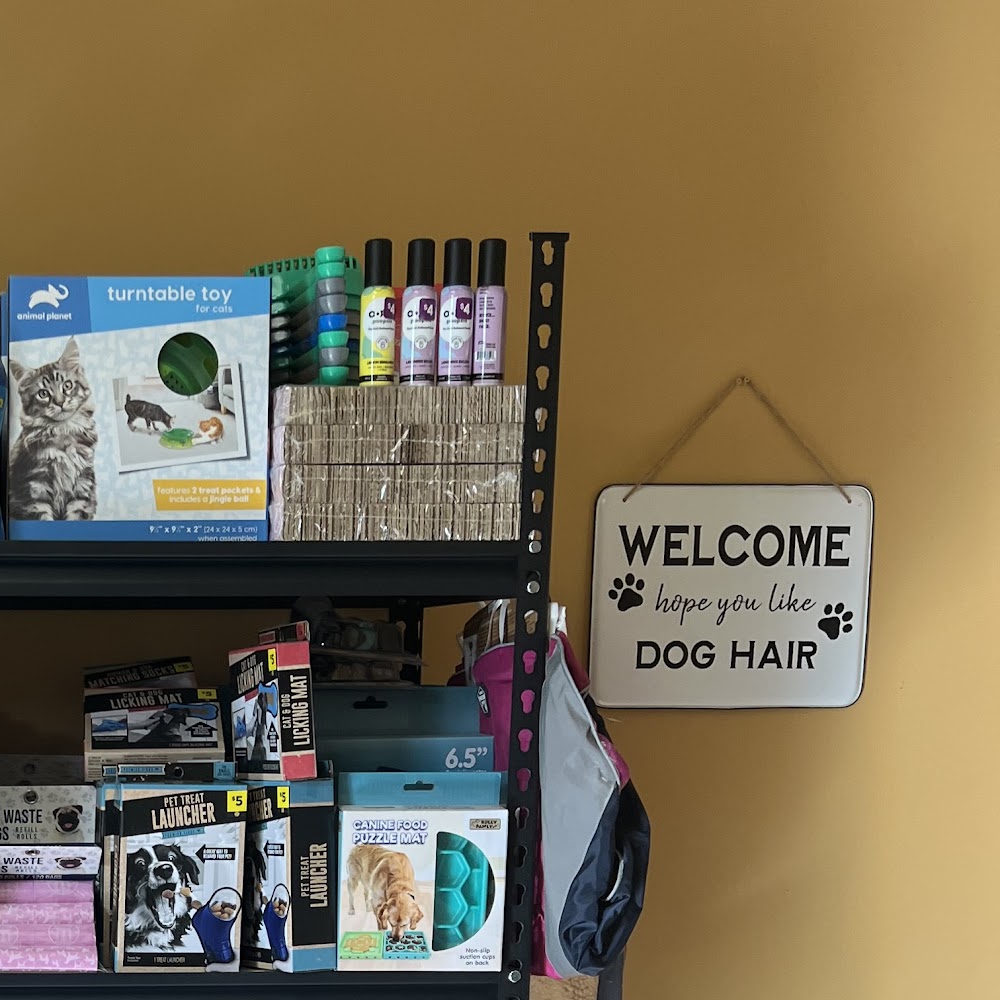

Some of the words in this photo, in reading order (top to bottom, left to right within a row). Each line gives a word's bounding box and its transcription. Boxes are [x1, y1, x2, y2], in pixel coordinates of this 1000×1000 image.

[107, 285, 196, 302] turntable
[201, 285, 232, 304] toy
[195, 304, 210, 313] for
[212, 304, 233, 313] cats
[423, 303, 434, 316] $4
[459, 302, 471, 315] $4
[17, 311, 46, 320] animal
[47, 311, 72, 322] planet
[157, 486, 191, 495] features
[192, 487, 198, 495] 2
[199, 486, 219, 495] treat
[221, 486, 254, 496] pockets
[169, 495, 201, 503] includes
[208, 494, 232, 505] jingle
[234, 494, 249, 503] ball
[618, 524, 851, 567] WELCOME
[655, 582, 713, 626] hope
[717, 594, 763, 626] you
[768, 583, 817, 613] like
[635, 640, 716, 669] DOG
[729, 640, 818, 670] HAIR
[87, 671, 141, 688] MATCHING
[142, 664, 176, 679] SOCKS
[290, 674, 308, 699] MAT
[109, 694, 156, 709] LICKING
[159, 692, 184, 704] MAT
[281, 693, 291, 707] DOG
[282, 716, 292, 729] CAT
[291, 700, 311, 747] LICKING
[163, 796, 178, 808] PET
[179, 792, 205, 805] TREAT
[231, 796, 243, 806] $5
[3, 809, 43, 824] WASTE
[151, 802, 216, 830] LAUNCHER
[352, 819, 396, 831] CANINE
[396, 819, 428, 831] FOOD
[352, 832, 398, 845] PUZZLE
[400, 832, 428, 845] MAT
[3, 857, 44, 865] WASTE
[300, 856, 310, 881] TREAT
[309, 842, 328, 908] LAUNCHER
[301, 882, 310, 897] PET
